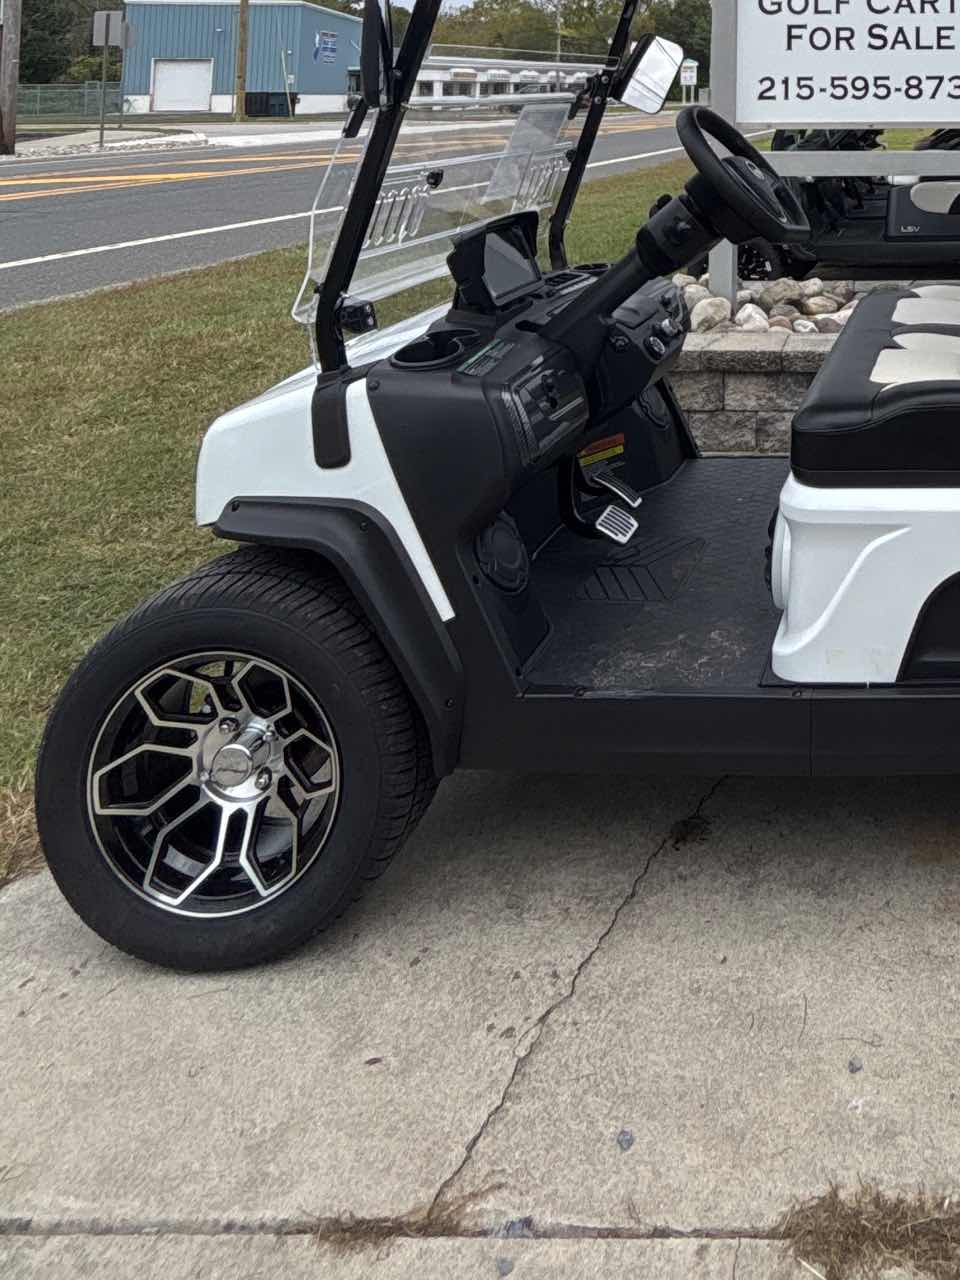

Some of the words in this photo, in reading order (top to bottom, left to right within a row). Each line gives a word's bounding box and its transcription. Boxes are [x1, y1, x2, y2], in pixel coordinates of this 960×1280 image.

[786, 23, 856, 51] FOR
[867, 23, 956, 51] SALE
[900, 225, 921, 233] LSV
